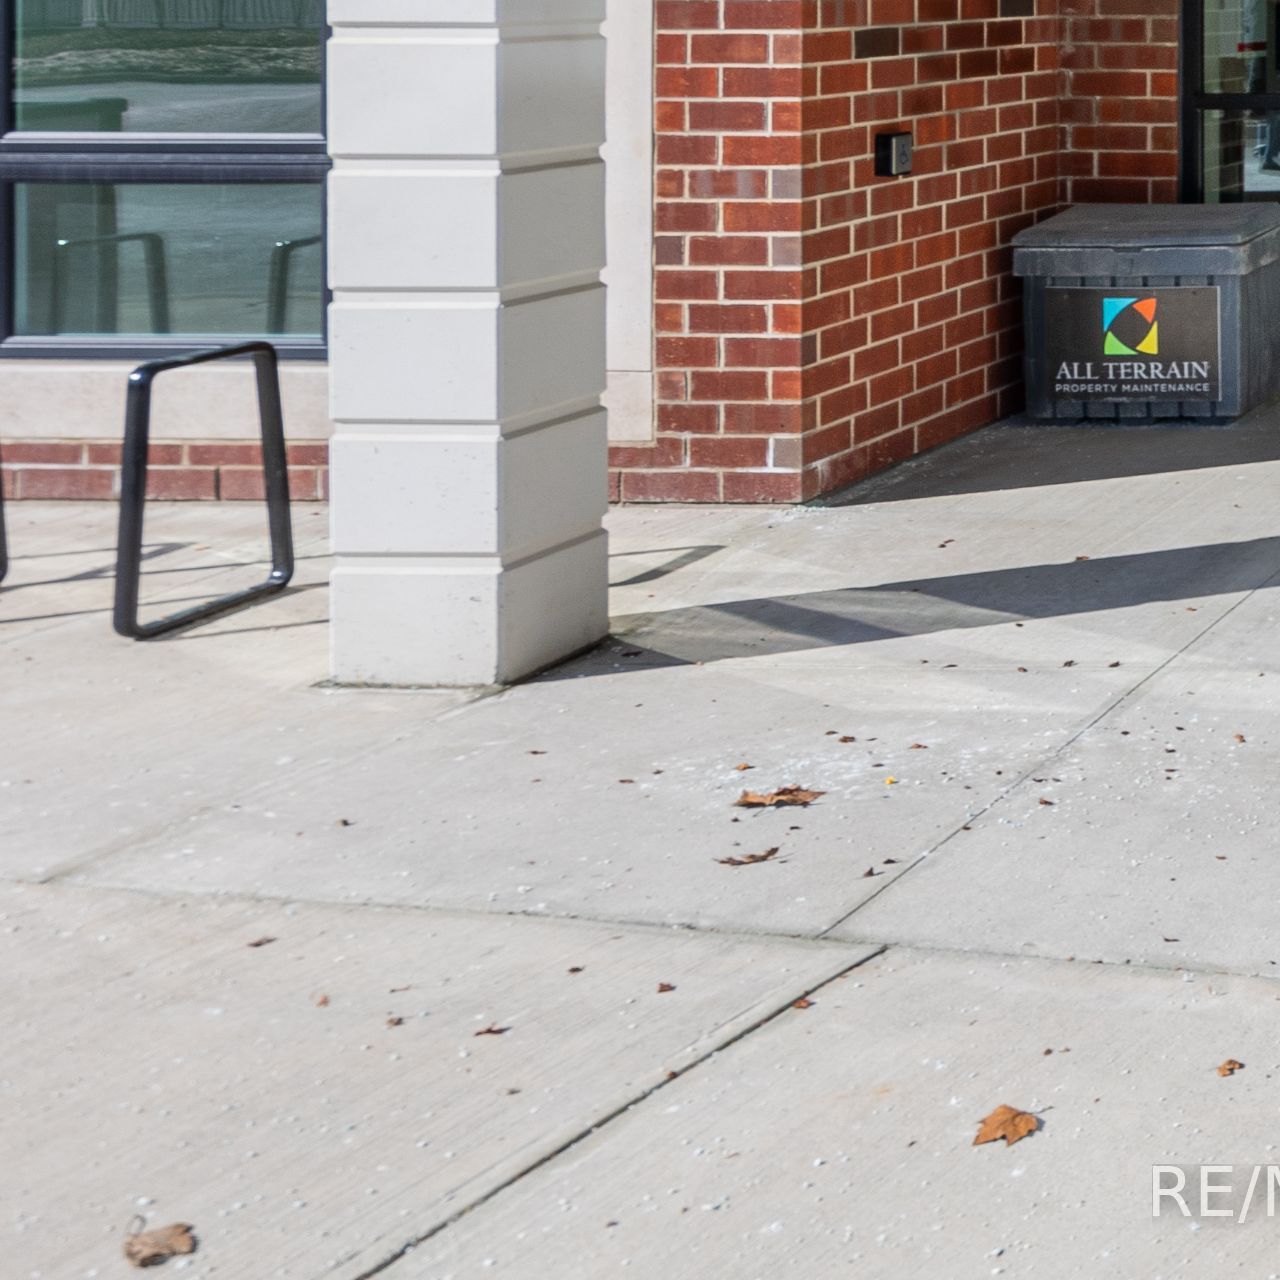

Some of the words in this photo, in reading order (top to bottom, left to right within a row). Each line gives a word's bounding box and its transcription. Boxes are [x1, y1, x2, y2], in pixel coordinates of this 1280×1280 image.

[1055, 361, 1099, 380] ALL
[1103, 361, 1210, 379] TERRAIN
[1055, 383, 1118, 393] PROPERTY
[1121, 382, 1210, 392] MAINTENANCE
